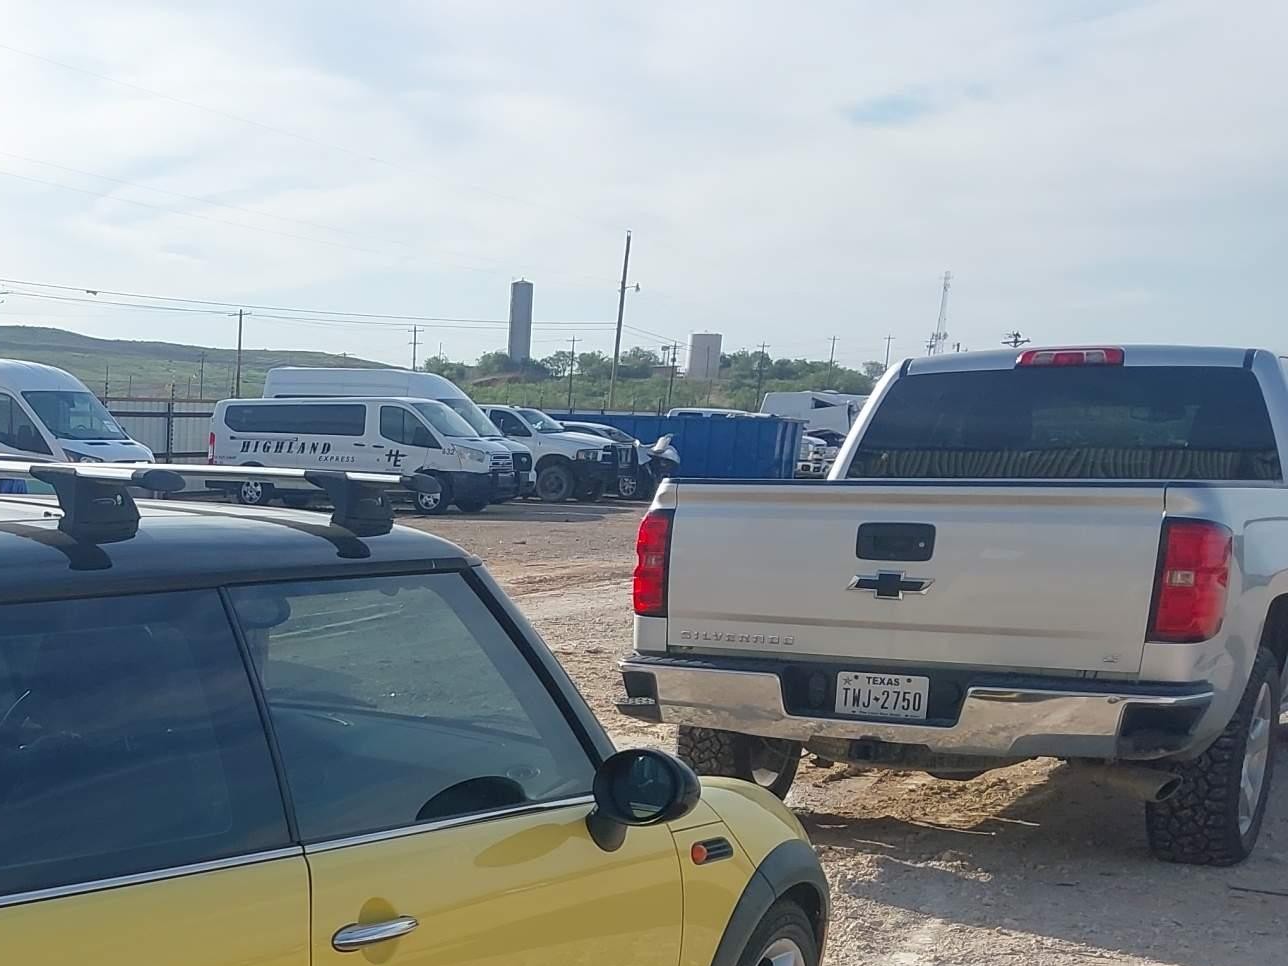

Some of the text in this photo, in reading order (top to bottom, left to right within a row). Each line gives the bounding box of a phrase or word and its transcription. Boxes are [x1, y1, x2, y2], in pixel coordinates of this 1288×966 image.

[240, 440, 332, 455] HIGHLAND
[318, 455, 355, 463] EXPRESS
[680, 630, 795, 646] SILVERADO
[866, 676, 900, 686] TEXAS
